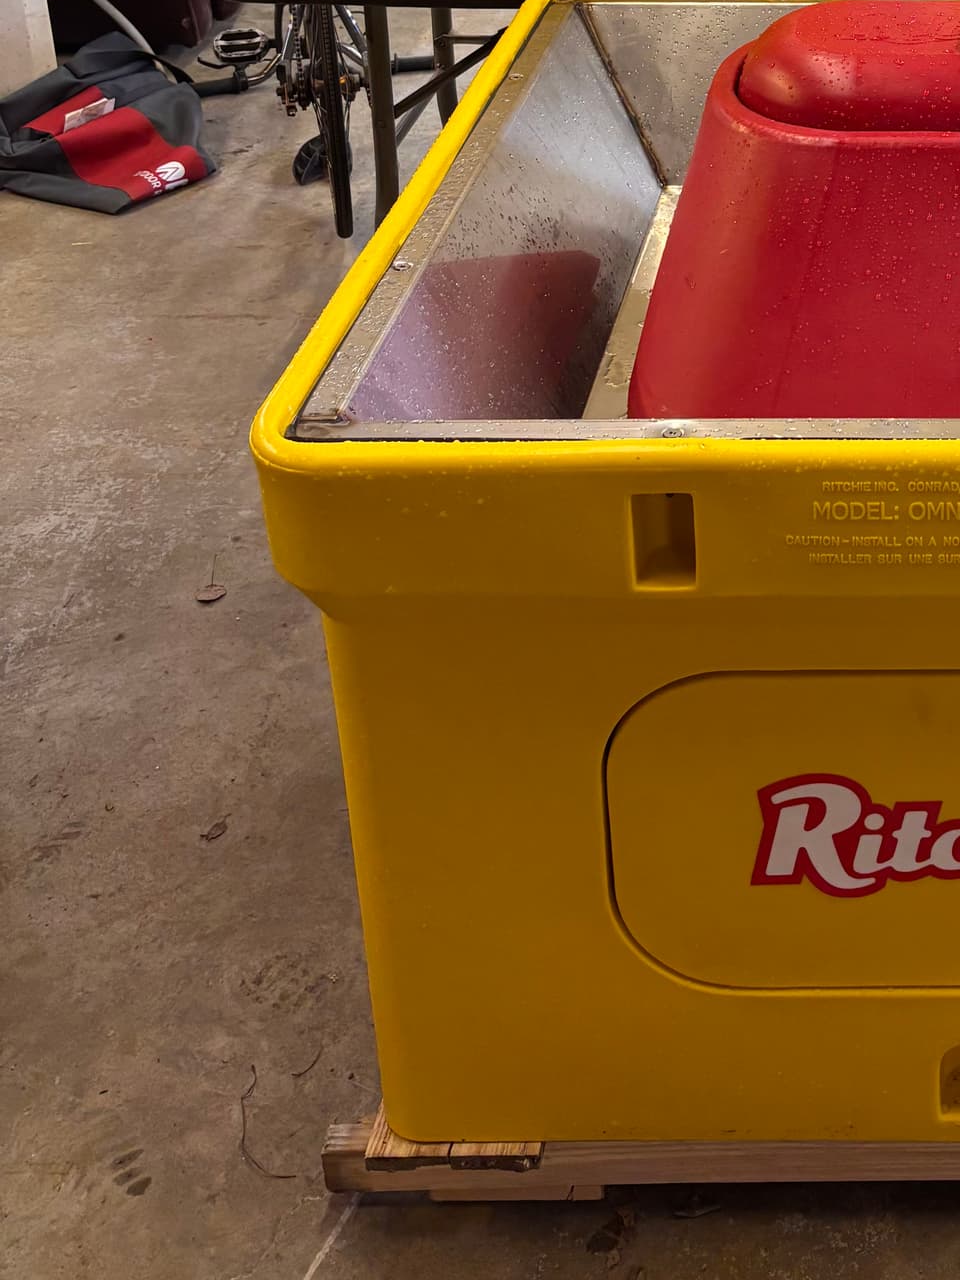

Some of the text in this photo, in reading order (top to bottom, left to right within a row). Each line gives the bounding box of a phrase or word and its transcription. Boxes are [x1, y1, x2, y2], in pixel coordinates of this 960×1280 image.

[821, 480, 872, 493] RITCHIE
[874, 480, 899, 493] INC.
[812, 501, 900, 521] MODEL:
[785, 534, 840, 546] CAUTION
[852, 535, 902, 547] INSTALL
[905, 535, 923, 547] ON
[927, 535, 937, 547] A
[808, 553, 872, 565] INSTALLER
[877, 553, 902, 565] SUR
[908, 553, 933, 565] UNE
